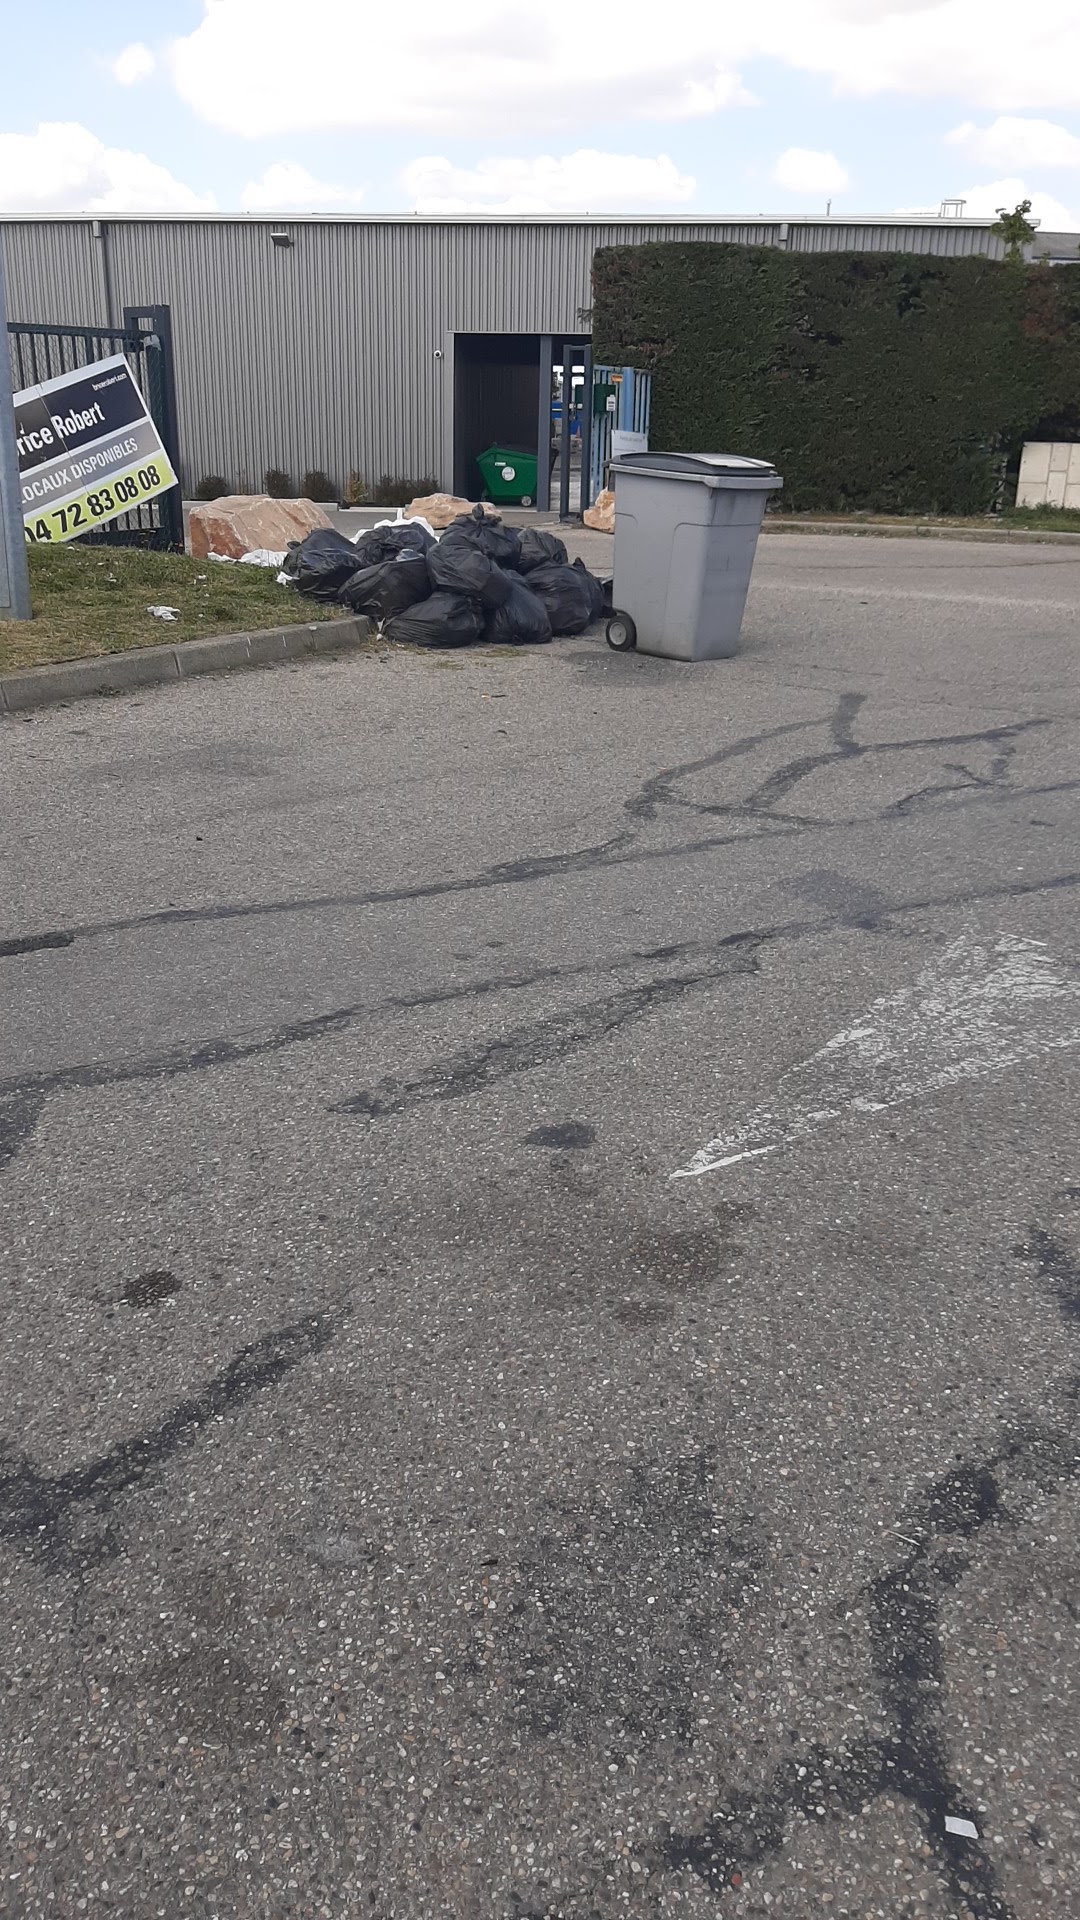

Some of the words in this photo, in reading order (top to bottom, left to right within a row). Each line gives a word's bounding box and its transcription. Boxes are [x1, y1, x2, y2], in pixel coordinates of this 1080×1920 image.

[17, 422, 54, 457] rice
[51, 402, 105, 438] Robert
[70, 438, 138, 479] DISPONIBLES
[52, 503, 87, 533] 72
[86, 488, 115, 518] 83
[114, 476, 139, 504] 08
[138, 465, 161, 491] 08
